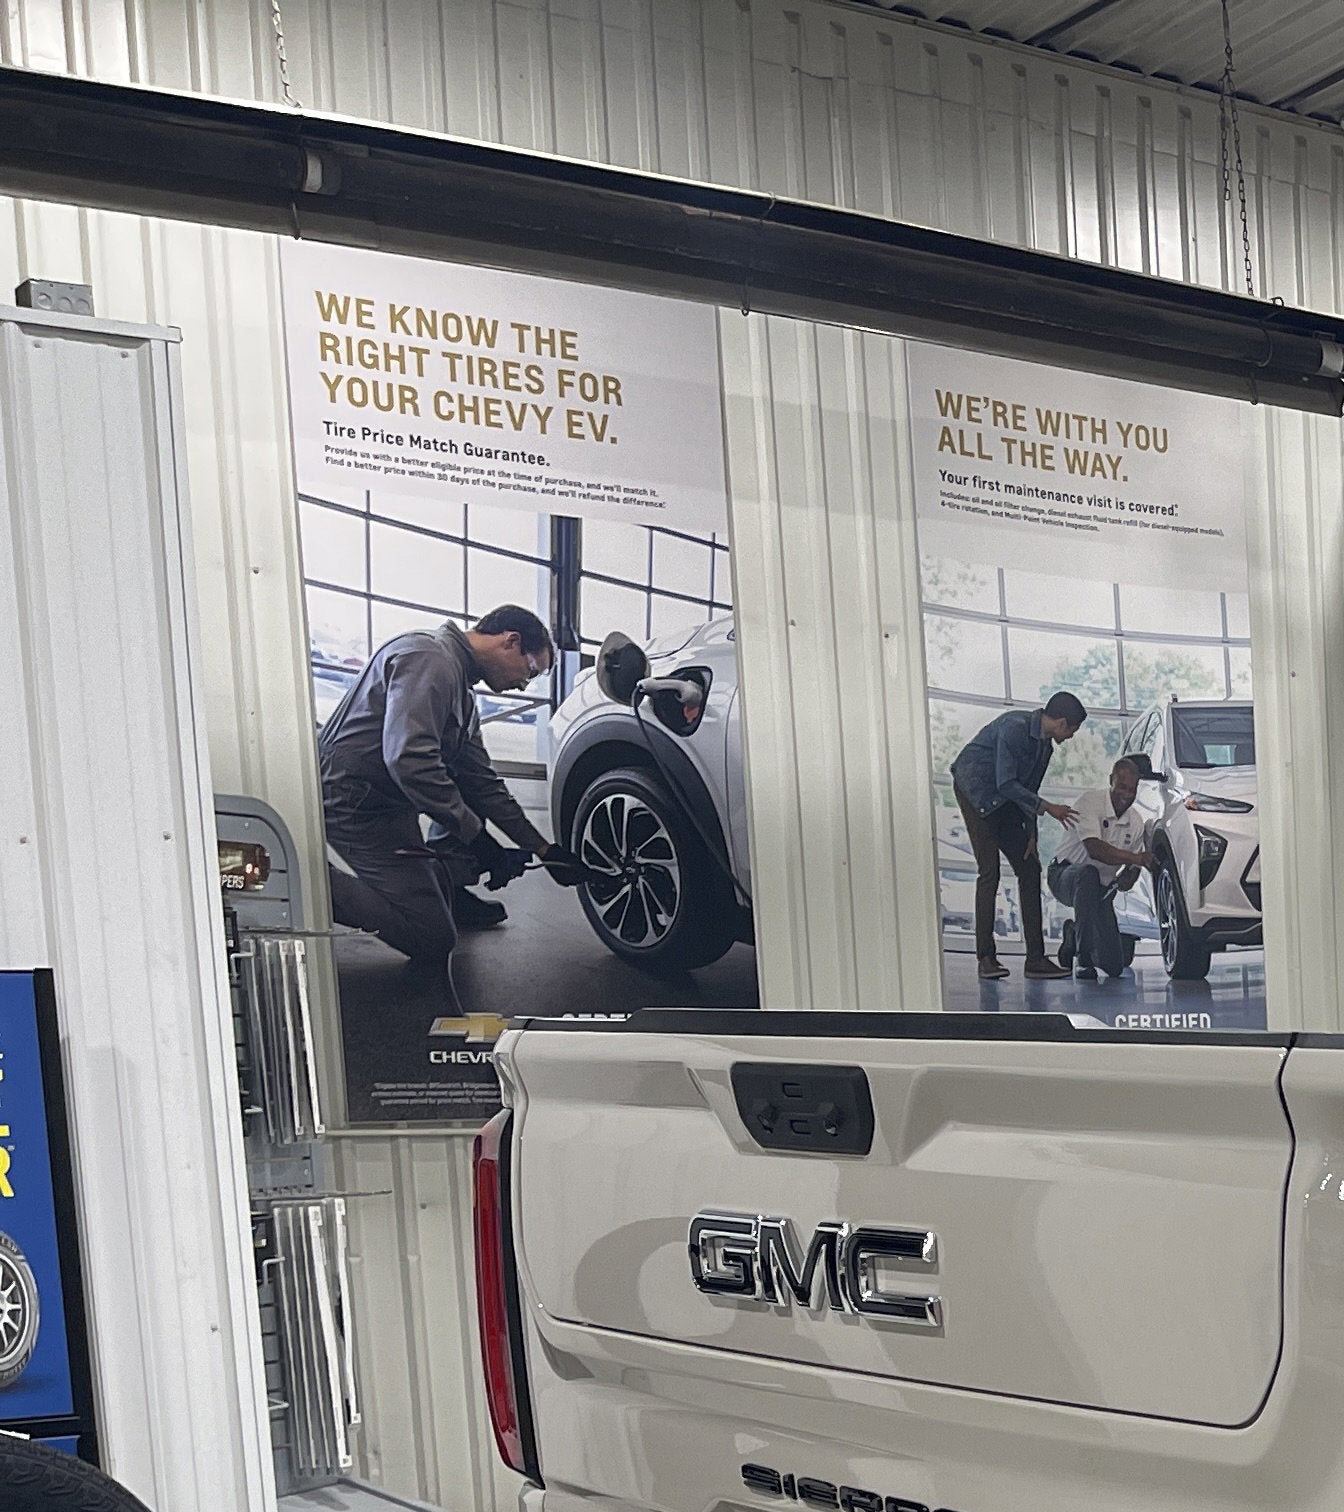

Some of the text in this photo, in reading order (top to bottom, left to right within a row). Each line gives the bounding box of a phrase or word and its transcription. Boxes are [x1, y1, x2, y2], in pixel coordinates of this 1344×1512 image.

[315, 290, 578, 361] WE KNOW THE
[319, 331, 622, 406] RIGHT TIRES FOR
[319, 371, 617, 444] YOUR CHEVY EV.
[935, 388, 1168, 453] WE'RE WITH YOU
[323, 420, 550, 466] Tire Price Match Guarantee.
[324, 444, 357, 457] Provide
[360, 450, 370, 459] us
[373, 453, 392, 462] with
[402, 457, 428, 468] better
[431, 462, 461, 472] eligible
[464, 466, 485, 475] price
[487, 468, 496, 477] at
[498, 470, 511, 479] the
[514, 472, 532, 482] time
[534, 475, 543, 483] of
[545, 477, 585, 489] purchase,
[587, 482, 601, 491] and
[623, 486, 648, 496] match
[937, 426, 1128, 482] ALL THE WAY.
[325, 456, 344, 466] Find
[354, 461, 381, 472] better
[384, 466, 406, 475] price
[408, 468, 435, 480] within
[437, 473, 448, 481] 30
[450, 474, 470, 485] days
[472, 477, 480, 486] of
[482, 479, 496, 488] the
[499, 481, 539, 494] purchase,
[541, 487, 556, 496] and
[558, 488, 576, 498] we'll
[578, 490, 605, 502] refund
[608, 495, 620, 504] the
[939, 469, 969, 486] Your
[973, 475, 1000, 492] first
[1004, 484, 1083, 505] maintenance
[1087, 494, 1112, 509] visit
[1115, 497, 1125, 510] is
[1115, 1013, 1211, 1029] CERTIFIED
[430, 1051, 493, 1063] CHEVR
[688, 1208, 943, 1327] GMC
